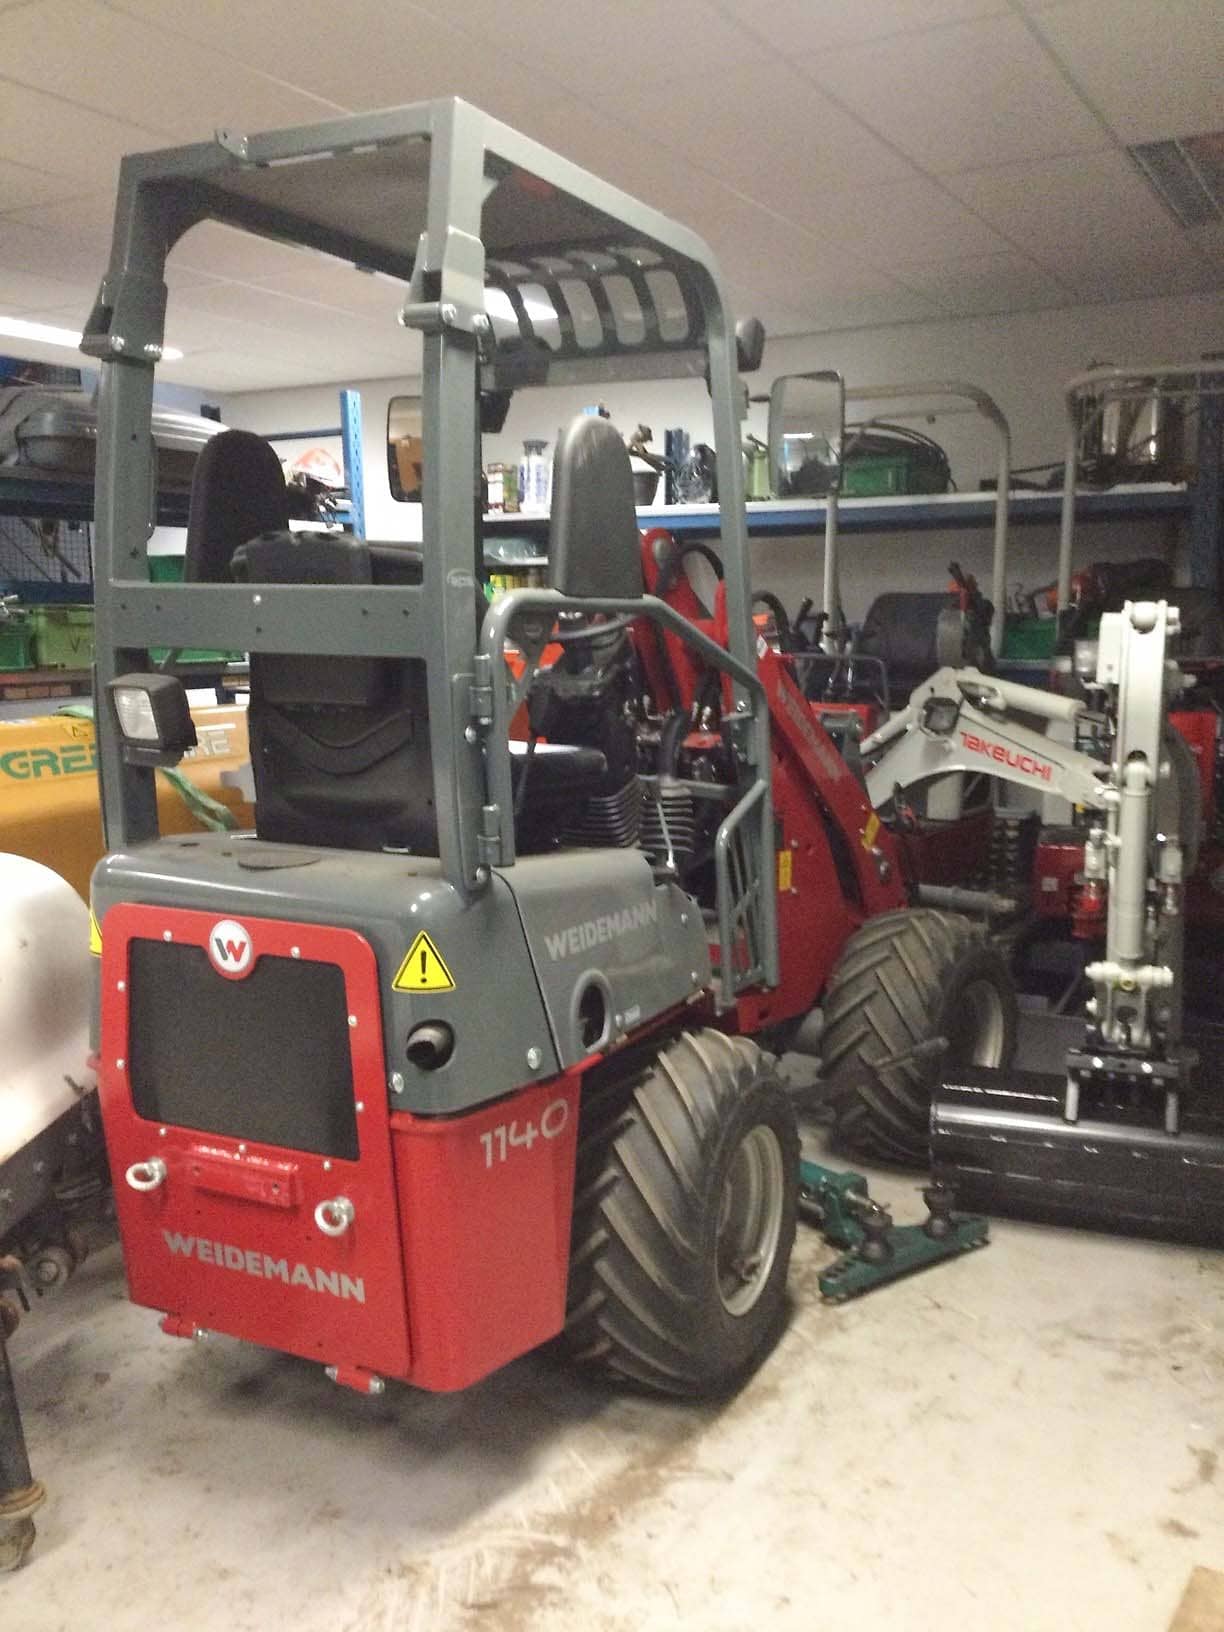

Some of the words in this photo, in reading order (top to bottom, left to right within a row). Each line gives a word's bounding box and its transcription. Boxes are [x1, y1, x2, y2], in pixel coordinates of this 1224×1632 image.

[0, 743, 98, 780] GRE
[543, 898, 658, 961] WEIDEMANN
[479, 1098, 568, 1169] 1140
[163, 1229, 366, 1304] WEIDEMANN
